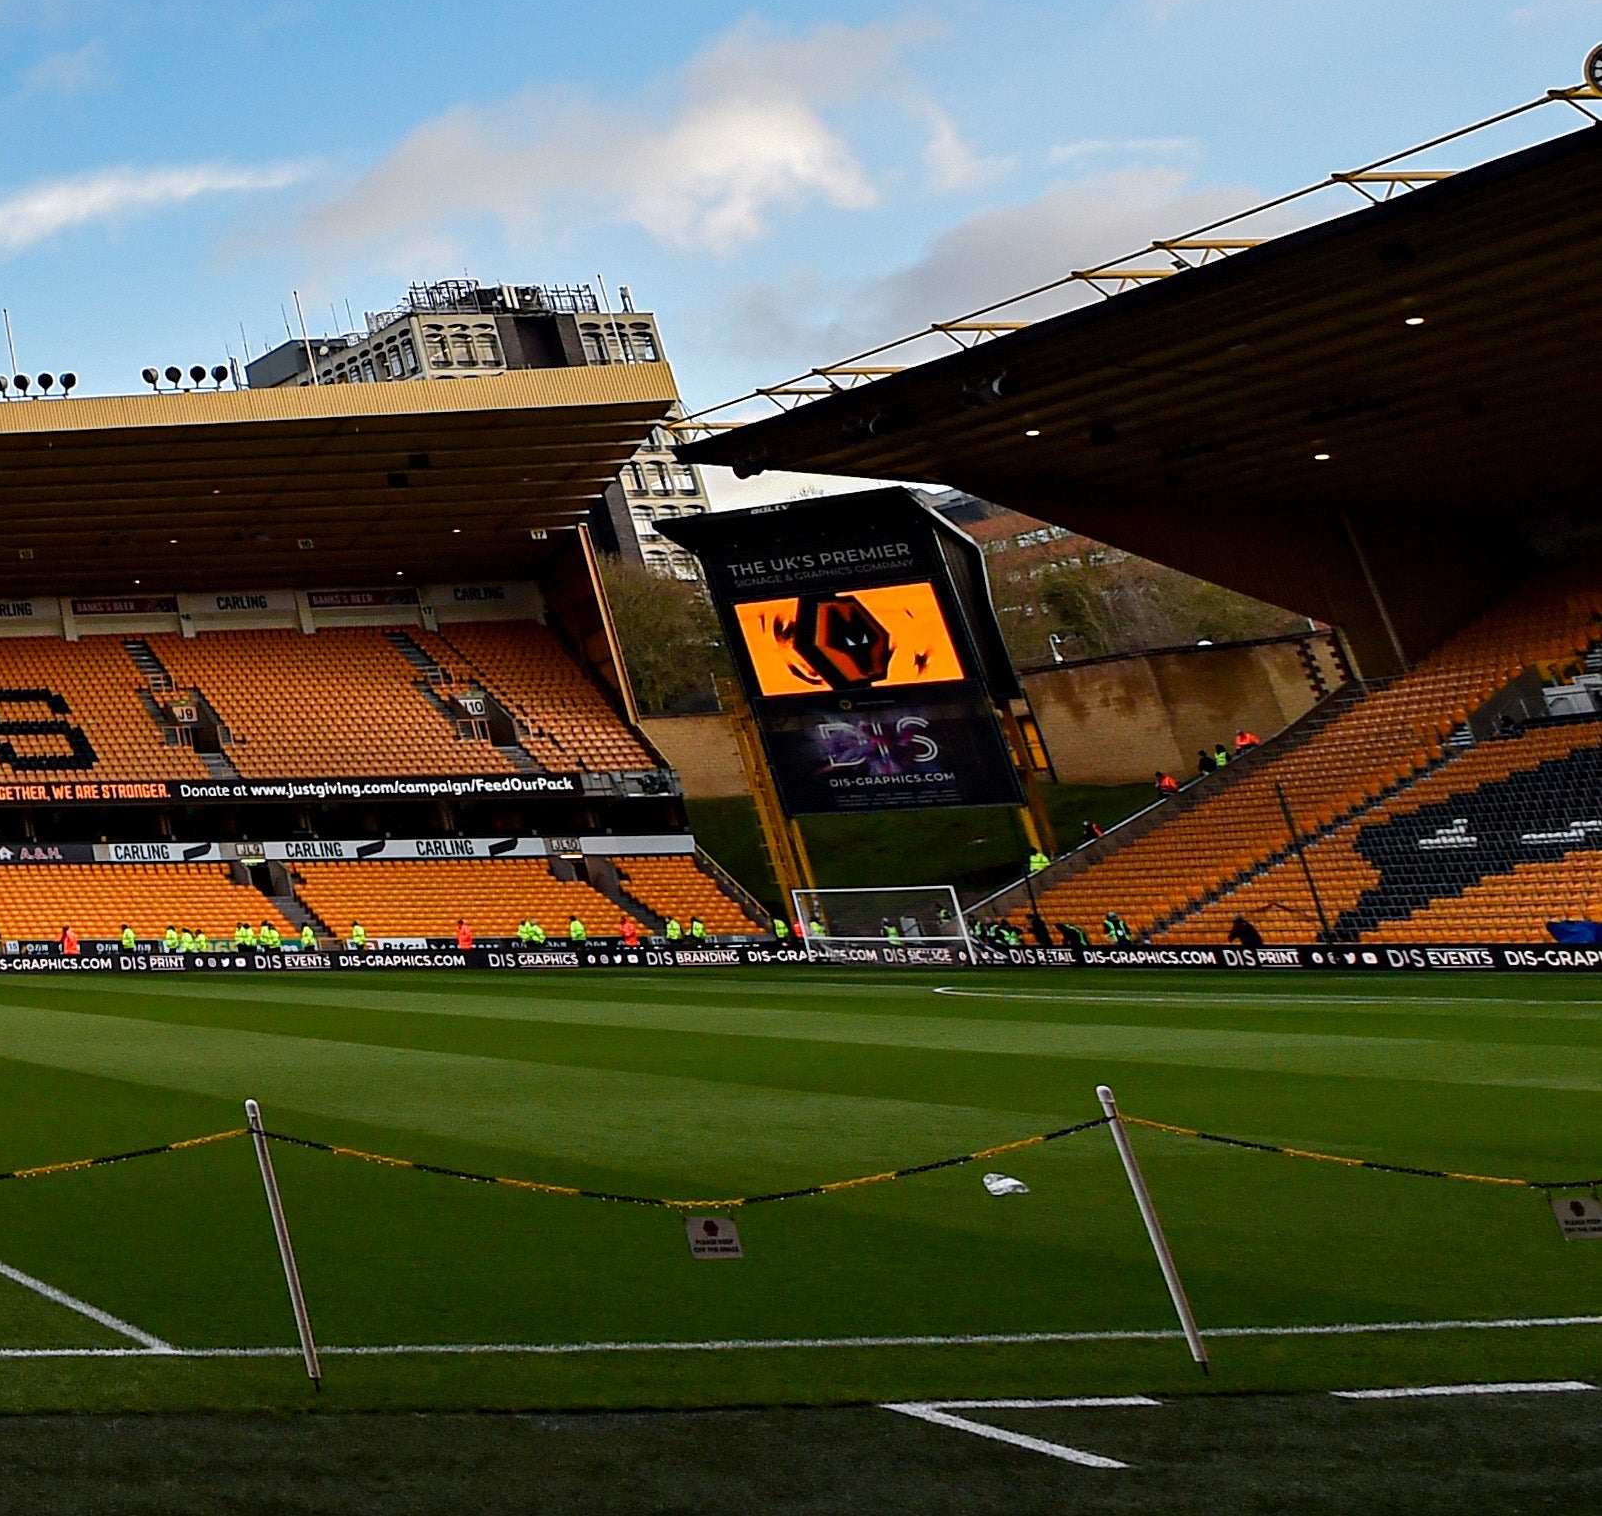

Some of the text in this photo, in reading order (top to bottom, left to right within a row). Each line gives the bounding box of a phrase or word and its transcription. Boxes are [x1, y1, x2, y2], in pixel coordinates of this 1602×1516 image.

[727, 543, 911, 577] THE UK'S PREMIER
[734, 571, 782, 588] SIGNAGE
[795, 566, 852, 580] GRAPHICS
[855, 559, 914, 574] COMPANY
[217, 595, 267, 610] CARLING
[180, 708, 193, 720] J9
[818, 716, 938, 767] DIS
[829, 772, 955, 787] DIS-GRAPHICS.COM
[52, 785, 73, 799] WE
[75, 785, 99, 799] ARE
[103, 784, 171, 799] STRONGER.
[180, 777, 574, 800] Donate at www.justgiving.com/campaign/FeedOurPack
[115, 845, 170, 860] CARLING
[286, 842, 343, 857] CARLING
[416, 840, 474, 855] CARLING
[120, 956, 185, 971] DIS PRINT
[488, 953, 579, 968] DIS GRAPHICS
[646, 951, 740, 966] DIS BRANDING
[883, 949, 906, 963] DIS
[1009, 949, 1035, 964] DIS
[1083, 950, 1218, 965] DIS-GRAPHICS.COM
[1222, 949, 1302, 967] DIS PRINT
[1387, 949, 1494, 967] DIS EVENTS
[1504, 951, 1602, 966] DIS-GRAP
